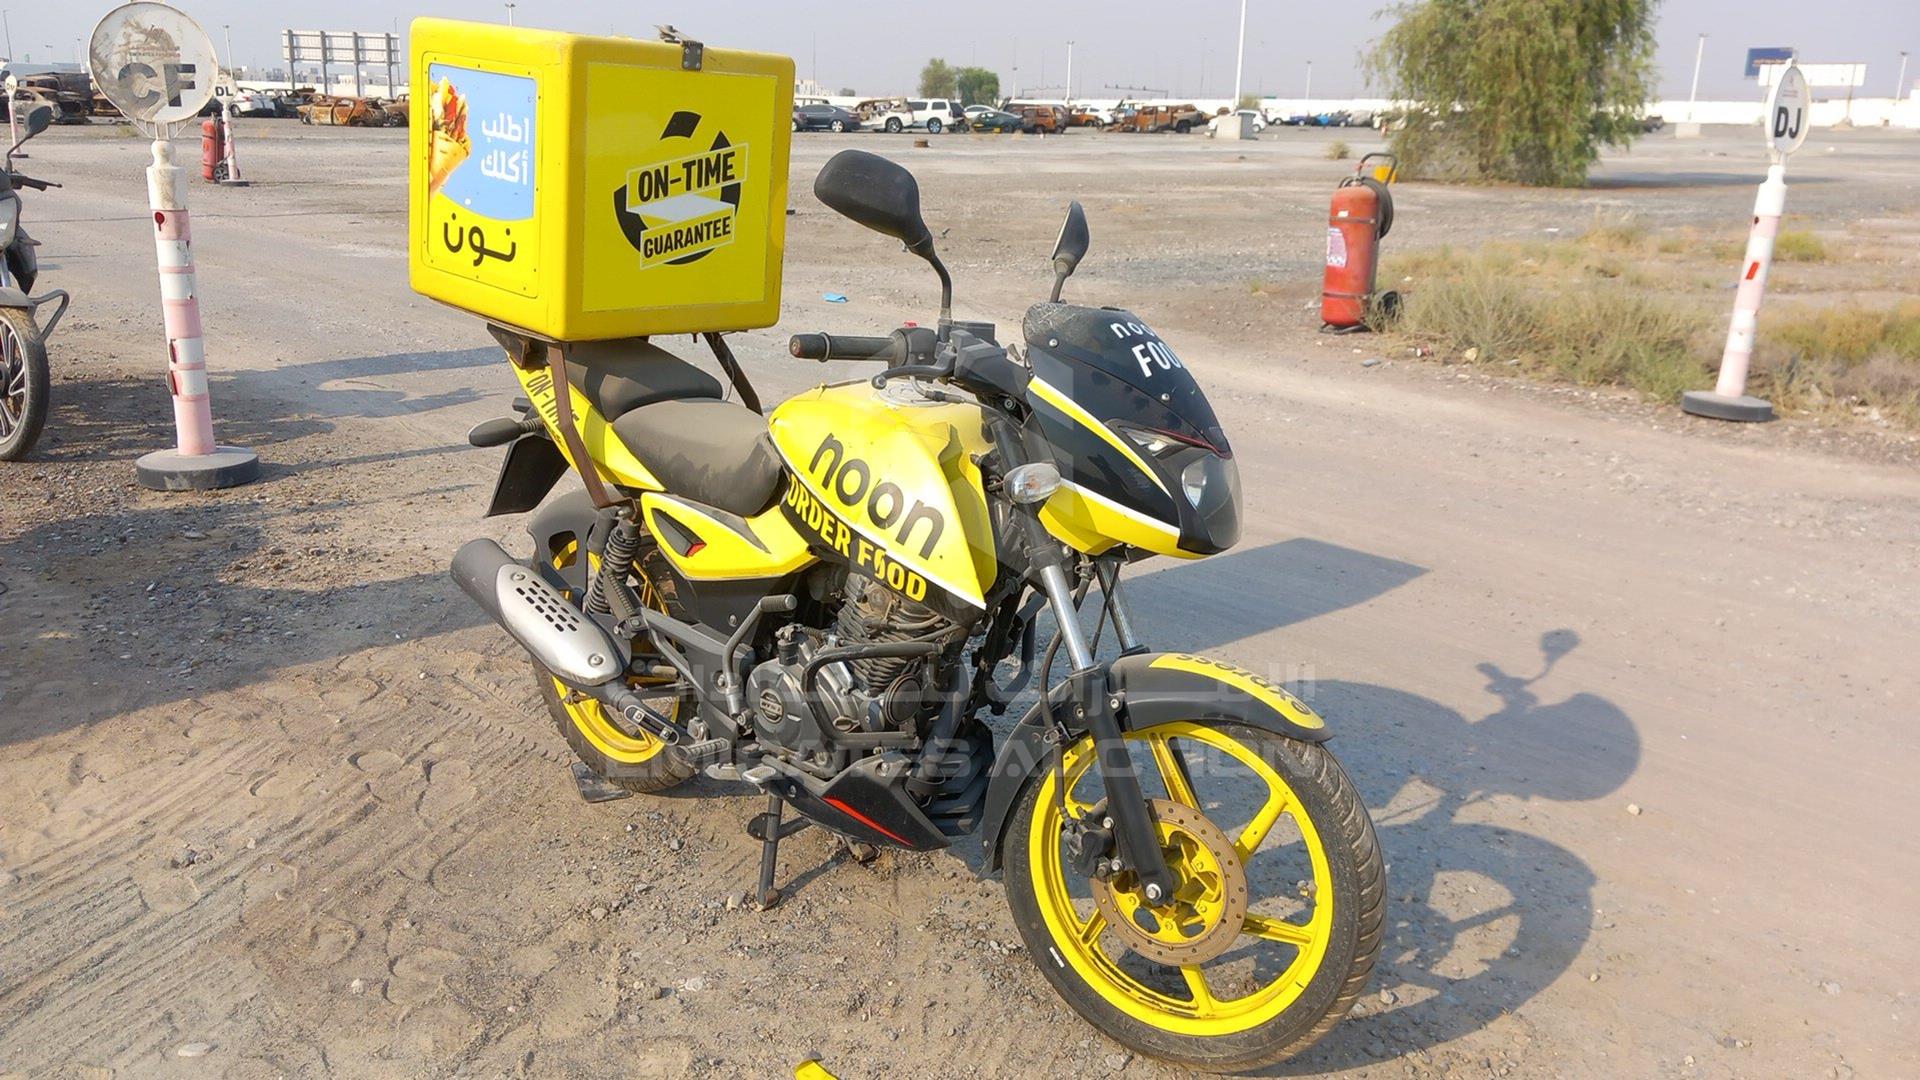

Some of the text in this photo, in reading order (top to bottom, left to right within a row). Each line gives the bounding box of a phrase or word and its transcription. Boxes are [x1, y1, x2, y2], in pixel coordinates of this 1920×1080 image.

[118, 62, 196, 107] CF
[215, 86, 234, 97] DL
[481, 112, 530, 145] اطلب
[1774, 106, 1802, 139] DJ
[480, 149, 529, 186] أكلك
[638, 151, 736, 203] ON-TIME
[443, 213, 517, 267] نون
[643, 216, 732, 259] GUARANTEE
[1110, 321, 1156, 339] noo
[1131, 341, 1182, 378] FOO
[787, 473, 852, 558] ORDER
[808, 432, 945, 561] noon
